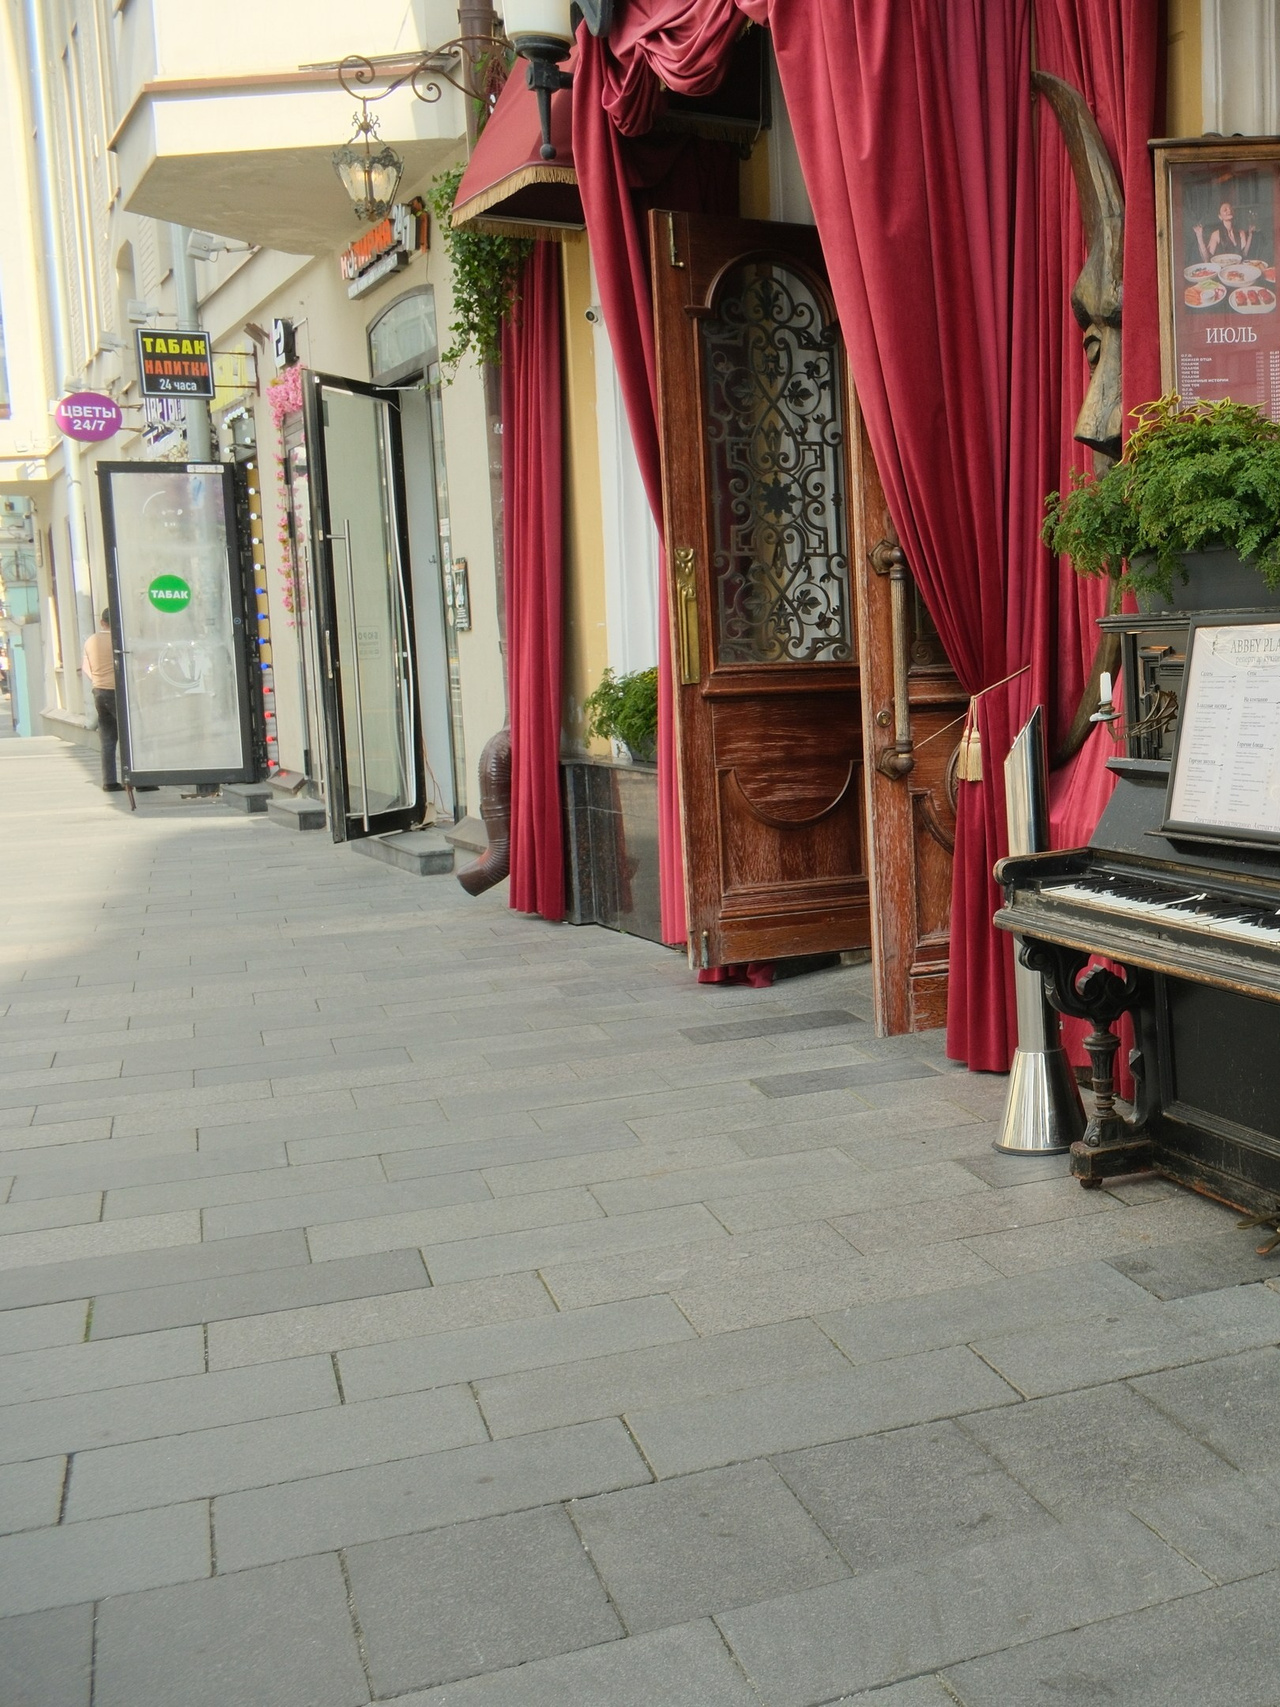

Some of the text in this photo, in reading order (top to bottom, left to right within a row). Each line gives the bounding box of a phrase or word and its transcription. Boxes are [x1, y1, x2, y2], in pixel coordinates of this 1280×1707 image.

[1205, 326, 1257, 344] ИЮЛЬ
[142, 337, 206, 355] ТАБАК
[144, 359, 209, 377] НАПИТКИ
[159, 378, 197, 391] 24 часа
[61, 405, 116, 419] ЦВЕТЫ
[73, 419, 106, 431] 24/7
[150, 589, 189, 599] ТАБАК
[1230, 638, 1262, 653] ABBEY
